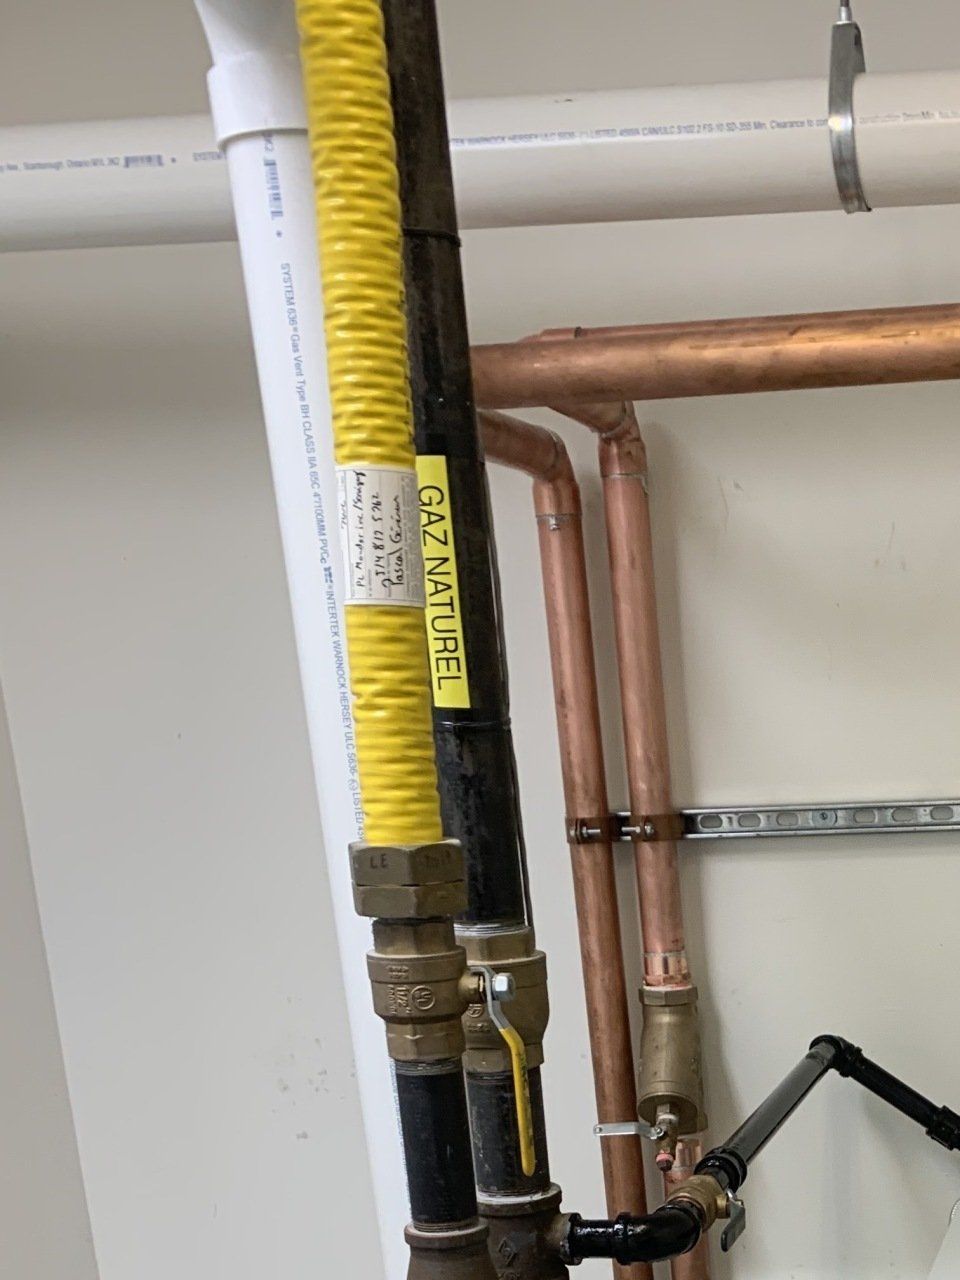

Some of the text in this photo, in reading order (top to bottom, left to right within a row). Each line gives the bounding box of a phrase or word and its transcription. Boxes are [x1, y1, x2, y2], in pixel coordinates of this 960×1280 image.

[281, 263, 296, 305] SYSTEM
[290, 334, 301, 353] Gas
[293, 356, 305, 376] Vent
[296, 379, 306, 402] Type
[300, 404, 310, 418] BH
[302, 421, 316, 454] CLASS
[381, 547, 405, 588] Pascal
[417, 485, 462, 690] GAZ NATUREL
[325, 590, 341, 638] INTERTEK
[332, 640, 347, 689] WARNOCK
[339, 692, 353, 730] HERSEY
[345, 731, 356, 750] ULC
[352, 792, 365, 824] LISTED
